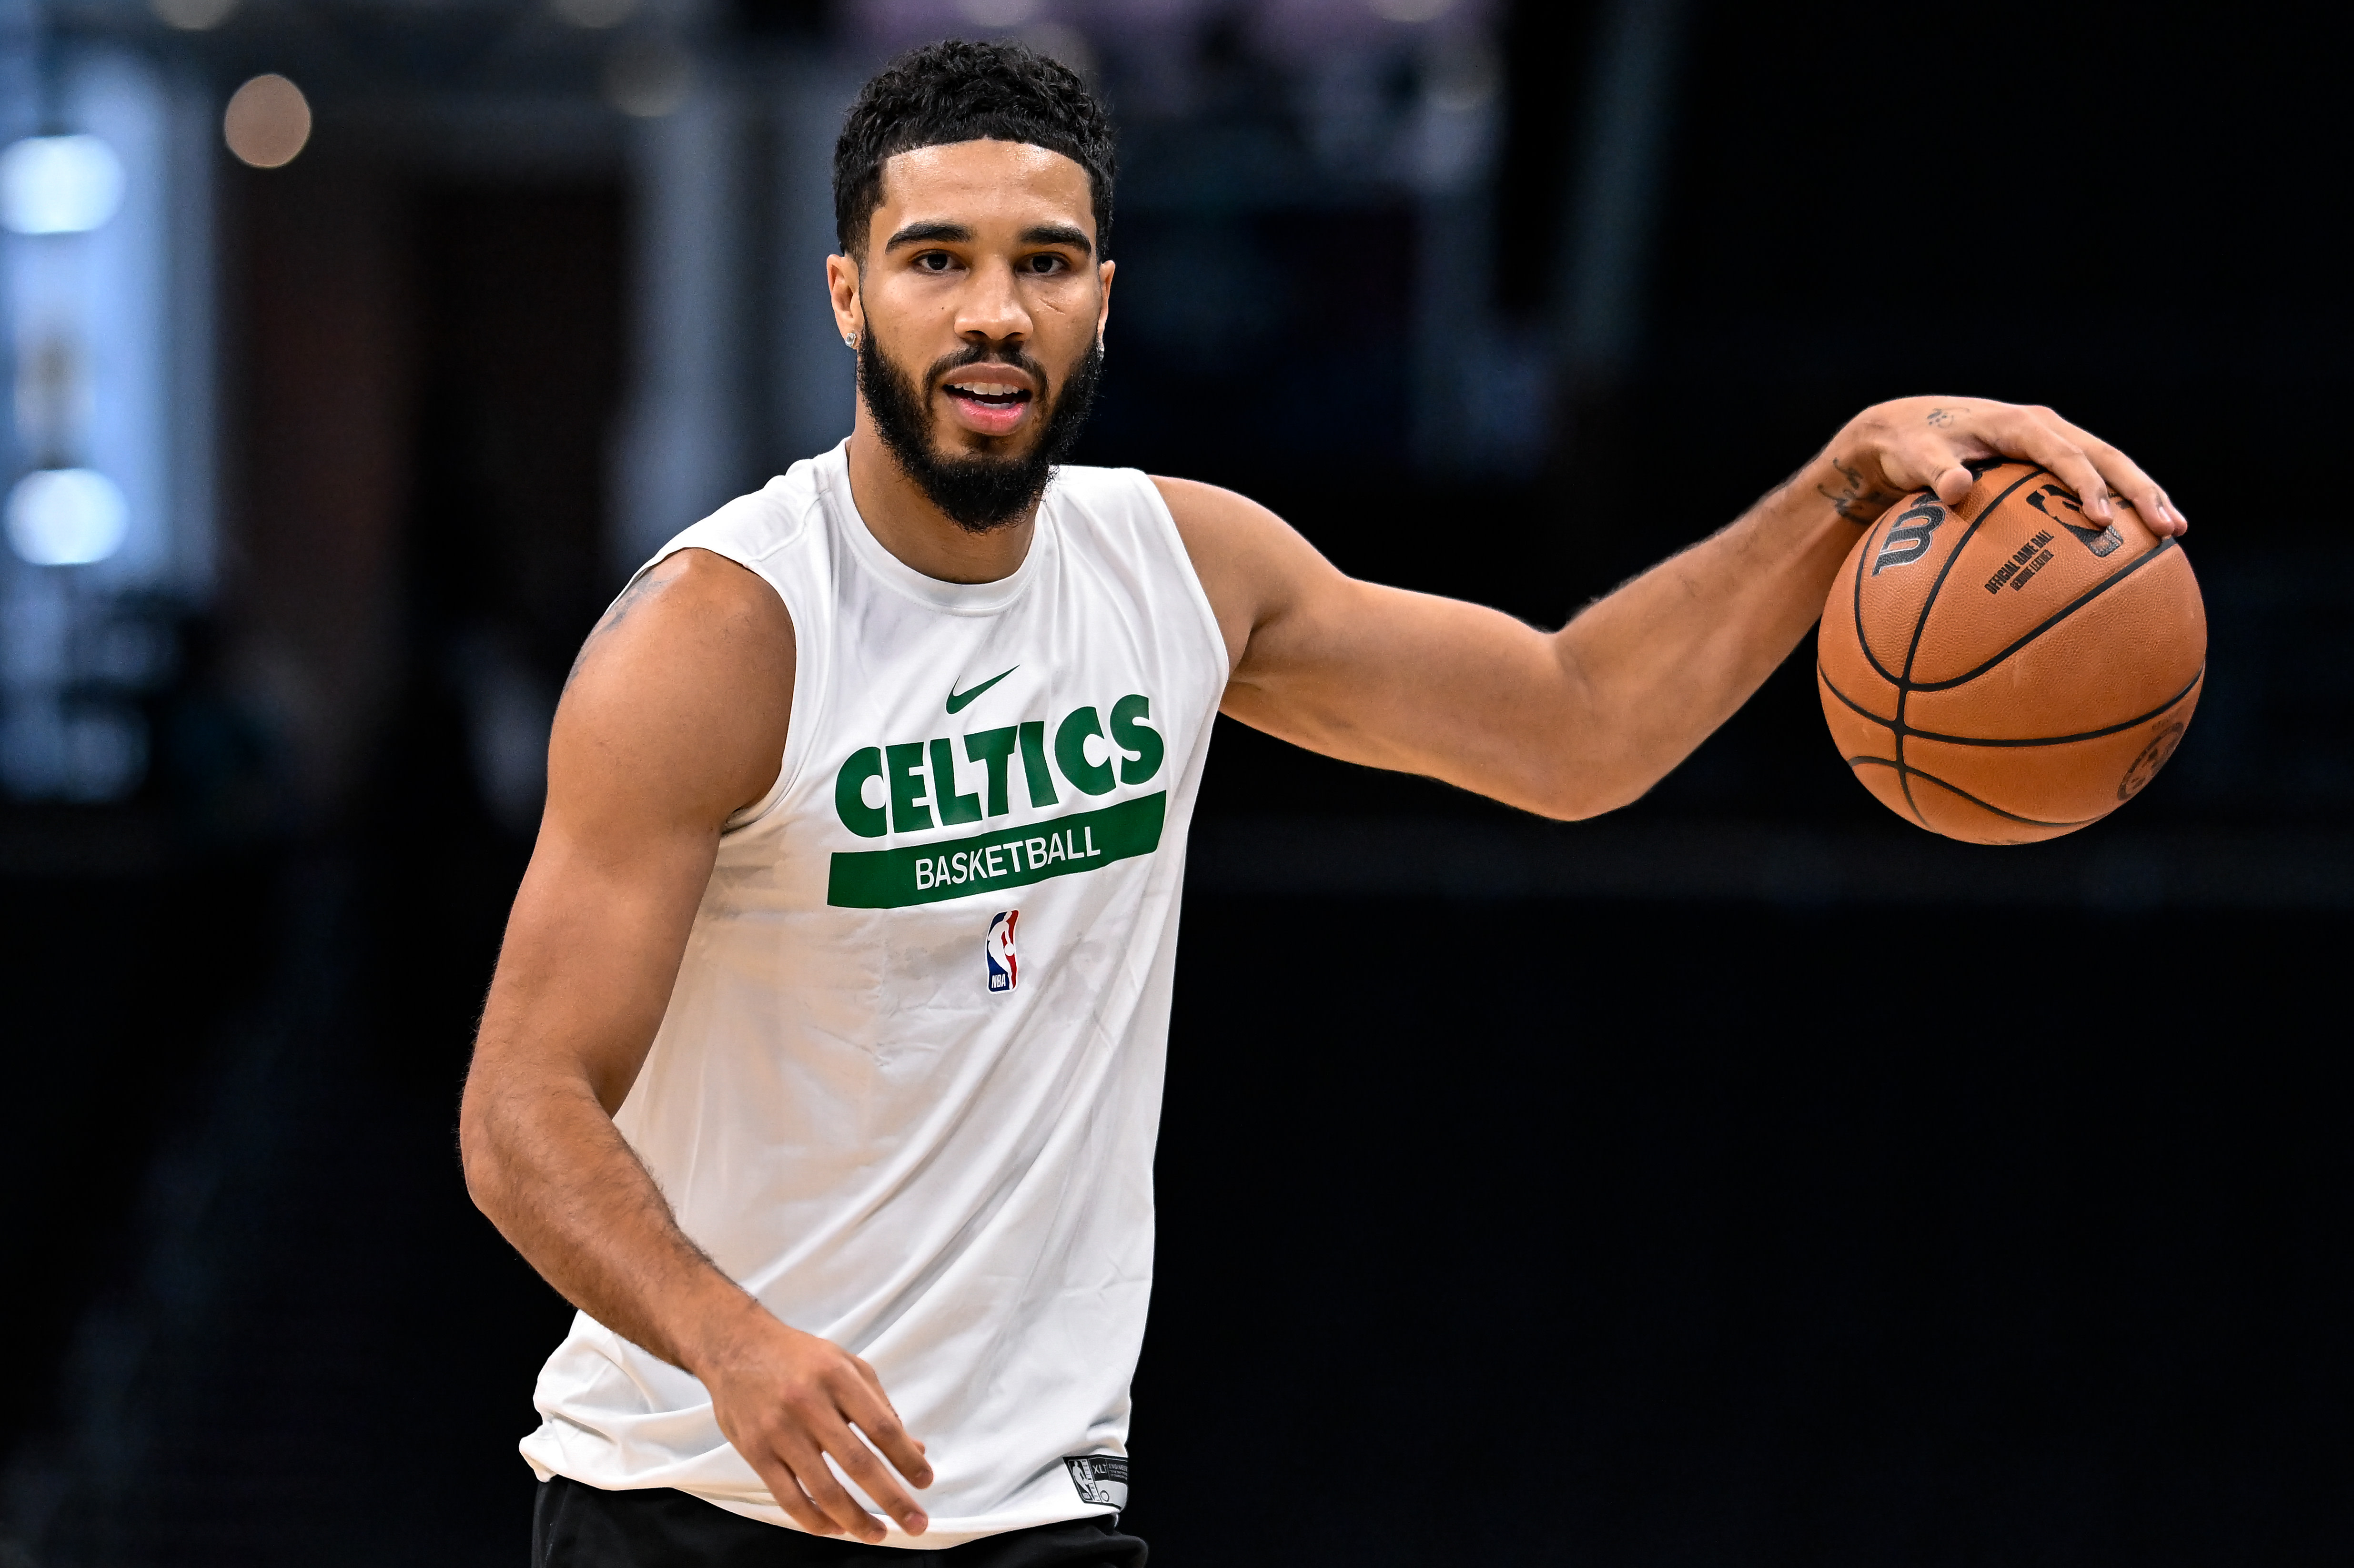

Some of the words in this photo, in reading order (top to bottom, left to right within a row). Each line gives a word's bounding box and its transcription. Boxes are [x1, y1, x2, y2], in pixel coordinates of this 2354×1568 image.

[1984, 559, 2021, 595] OFFICIAL
[2012, 542, 2039, 565] GAME
[2030, 529, 2055, 548] BALL
[2010, 566, 2035, 591] GENUINE
[2029, 549, 2054, 572] LEATHER
[835, 694, 1164, 838] CELTICS
[916, 826, 1101, 890] BASKETBALL
[991, 973, 1006, 988] NBA
[1092, 1464, 1107, 1474] XLT
